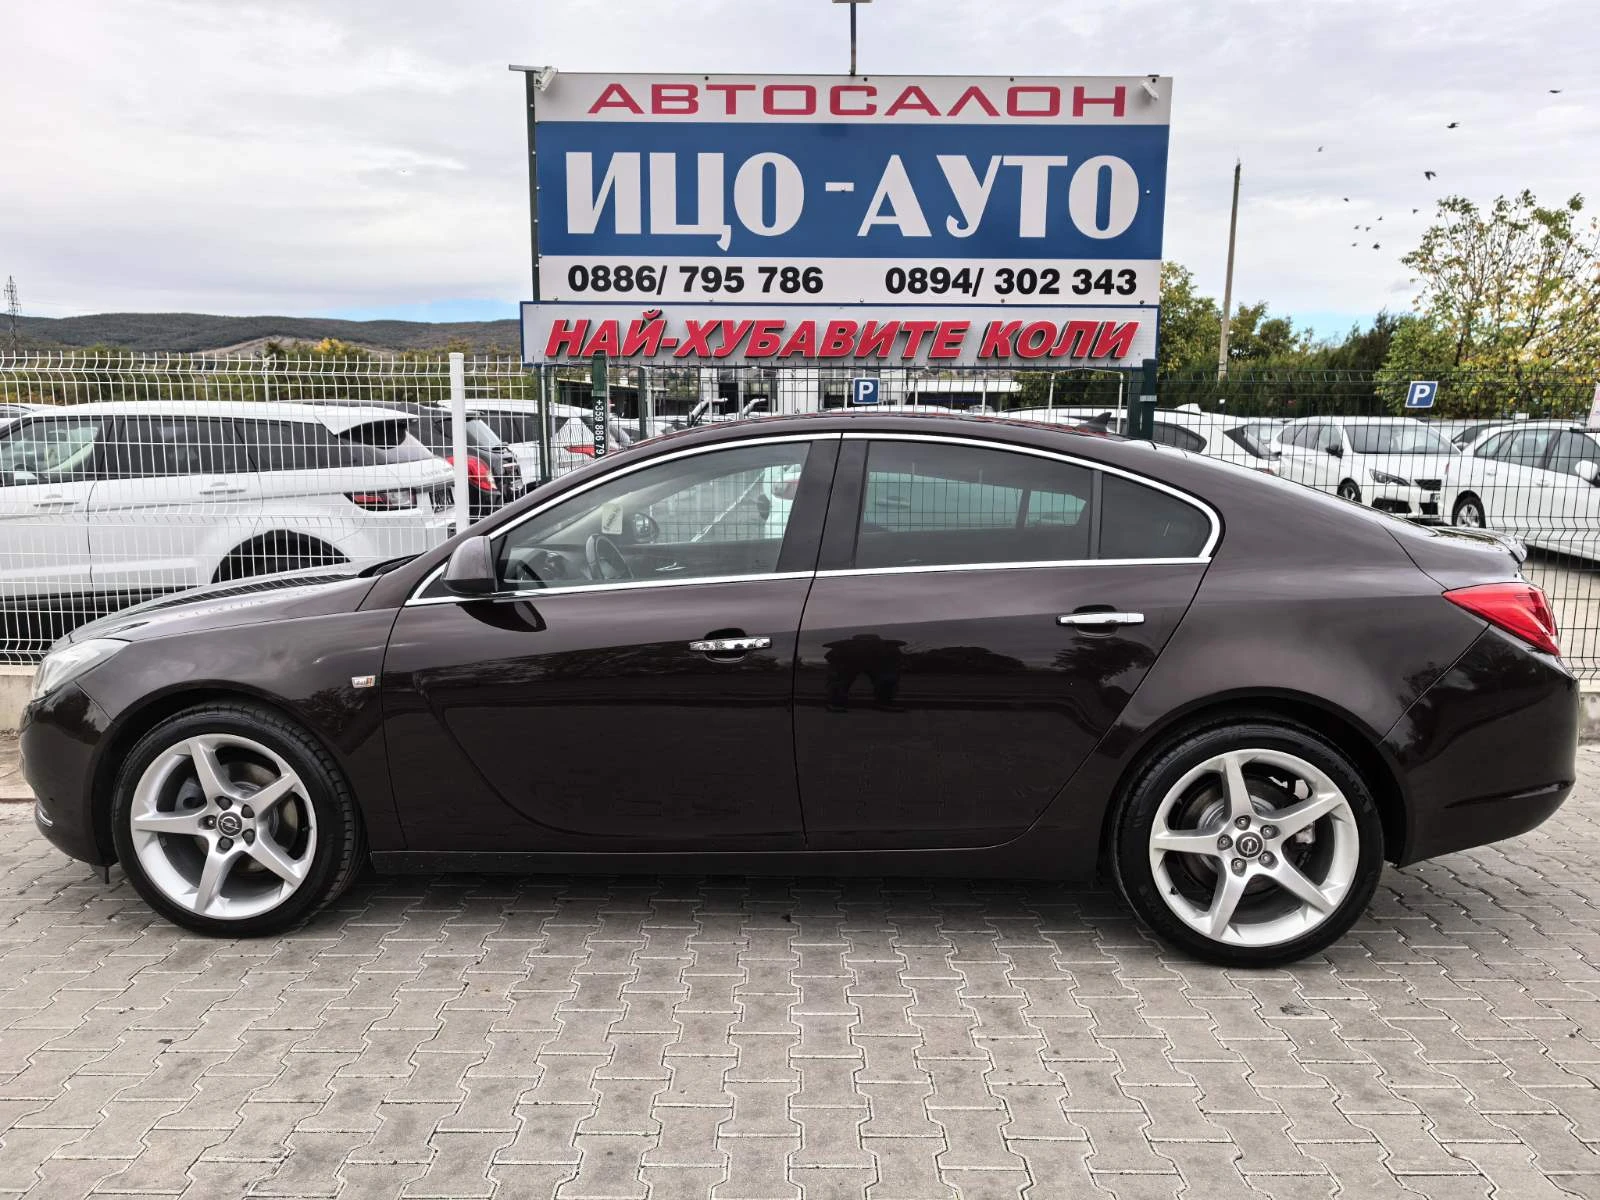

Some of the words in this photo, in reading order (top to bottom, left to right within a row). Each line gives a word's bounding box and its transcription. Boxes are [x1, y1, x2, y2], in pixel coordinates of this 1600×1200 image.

[587, 83, 1126, 117] АВТОСАЛОН
[567, 264, 668, 295] 0886/
[679, 265, 745, 294] 795
[758, 266, 824, 294] 786
[885, 266, 984, 297] 0894/
[994, 267, 1061, 295] 302
[1072, 268, 1137, 296] 343
[544, 308, 972, 359] НАЙ-ХУБАВИТЕ
[977, 320, 1141, 359] КОЛИ
[858, 381, 874, 401] P
[1411, 384, 1431, 405] P
